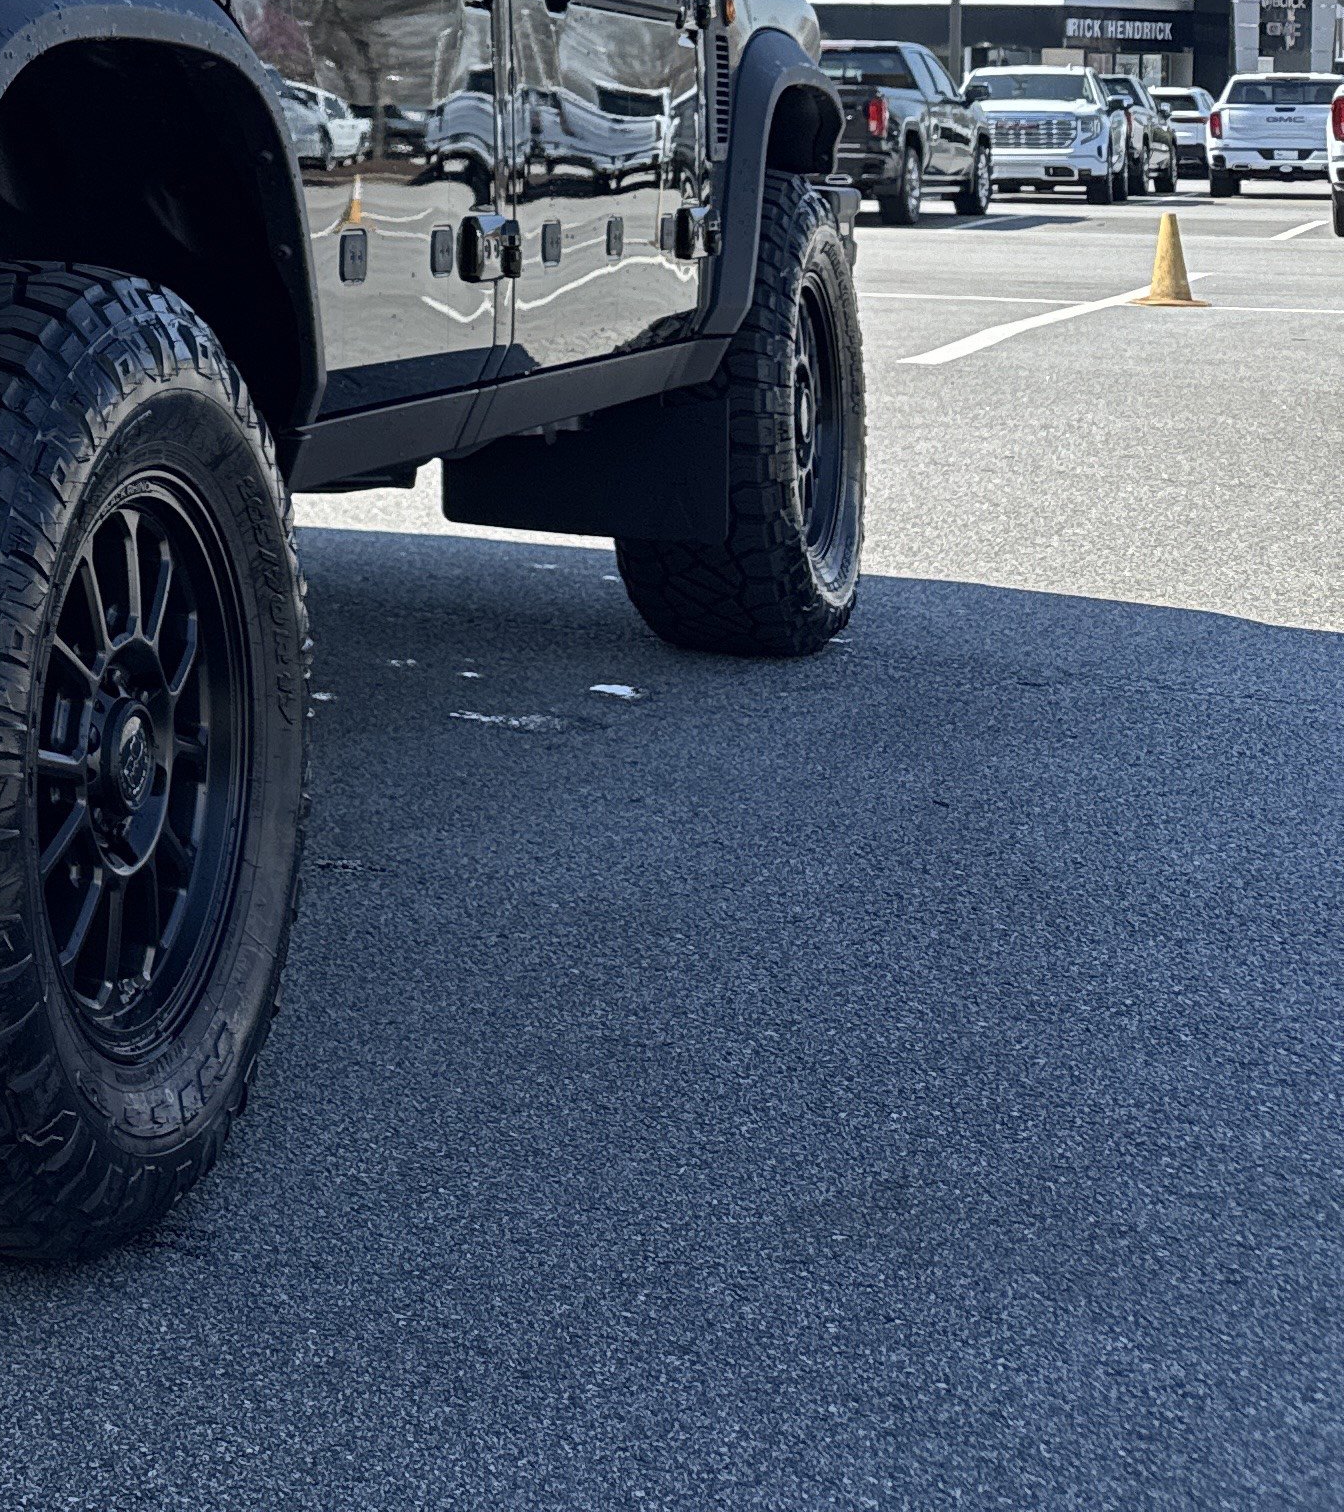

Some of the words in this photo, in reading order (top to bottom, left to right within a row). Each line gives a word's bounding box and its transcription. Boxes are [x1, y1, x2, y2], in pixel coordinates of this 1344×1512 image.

[1065, 18, 1101, 38] RICK
[1107, 20, 1173, 40] HENDRICK
[1266, 115, 1306, 124] GMC
